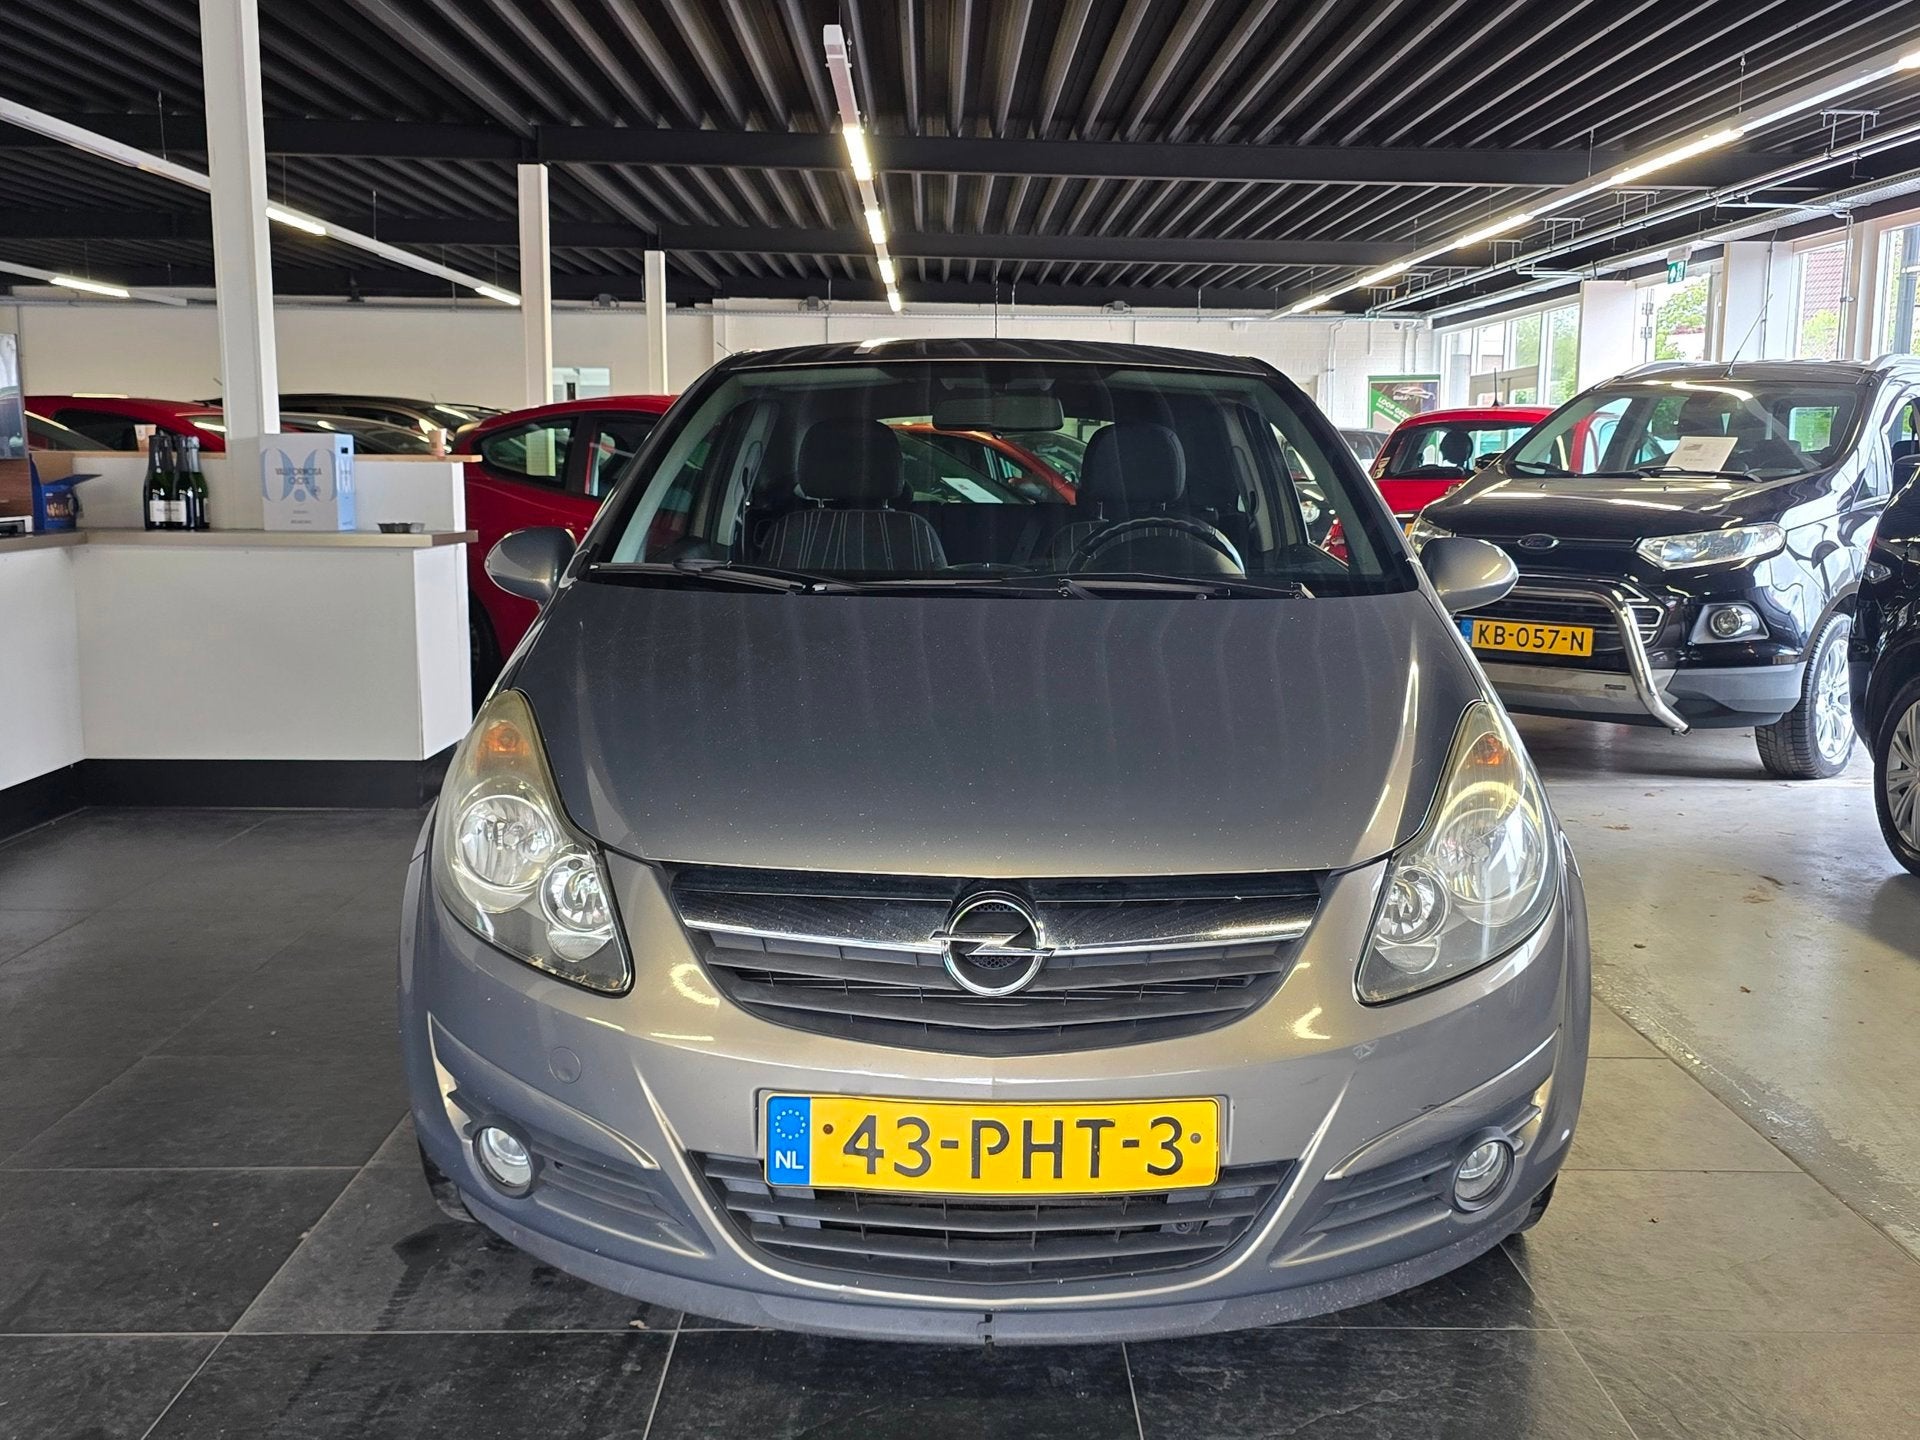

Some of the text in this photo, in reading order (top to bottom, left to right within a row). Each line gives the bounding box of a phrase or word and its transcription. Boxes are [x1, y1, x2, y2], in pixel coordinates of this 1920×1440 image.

[1378, 397, 1396, 410] LOOP
[1477, 623, 1585, 652] KB-057-N
[841, 1114, 1184, 1180] 43-PHT-3
[775, 1150, 804, 1171] NL
